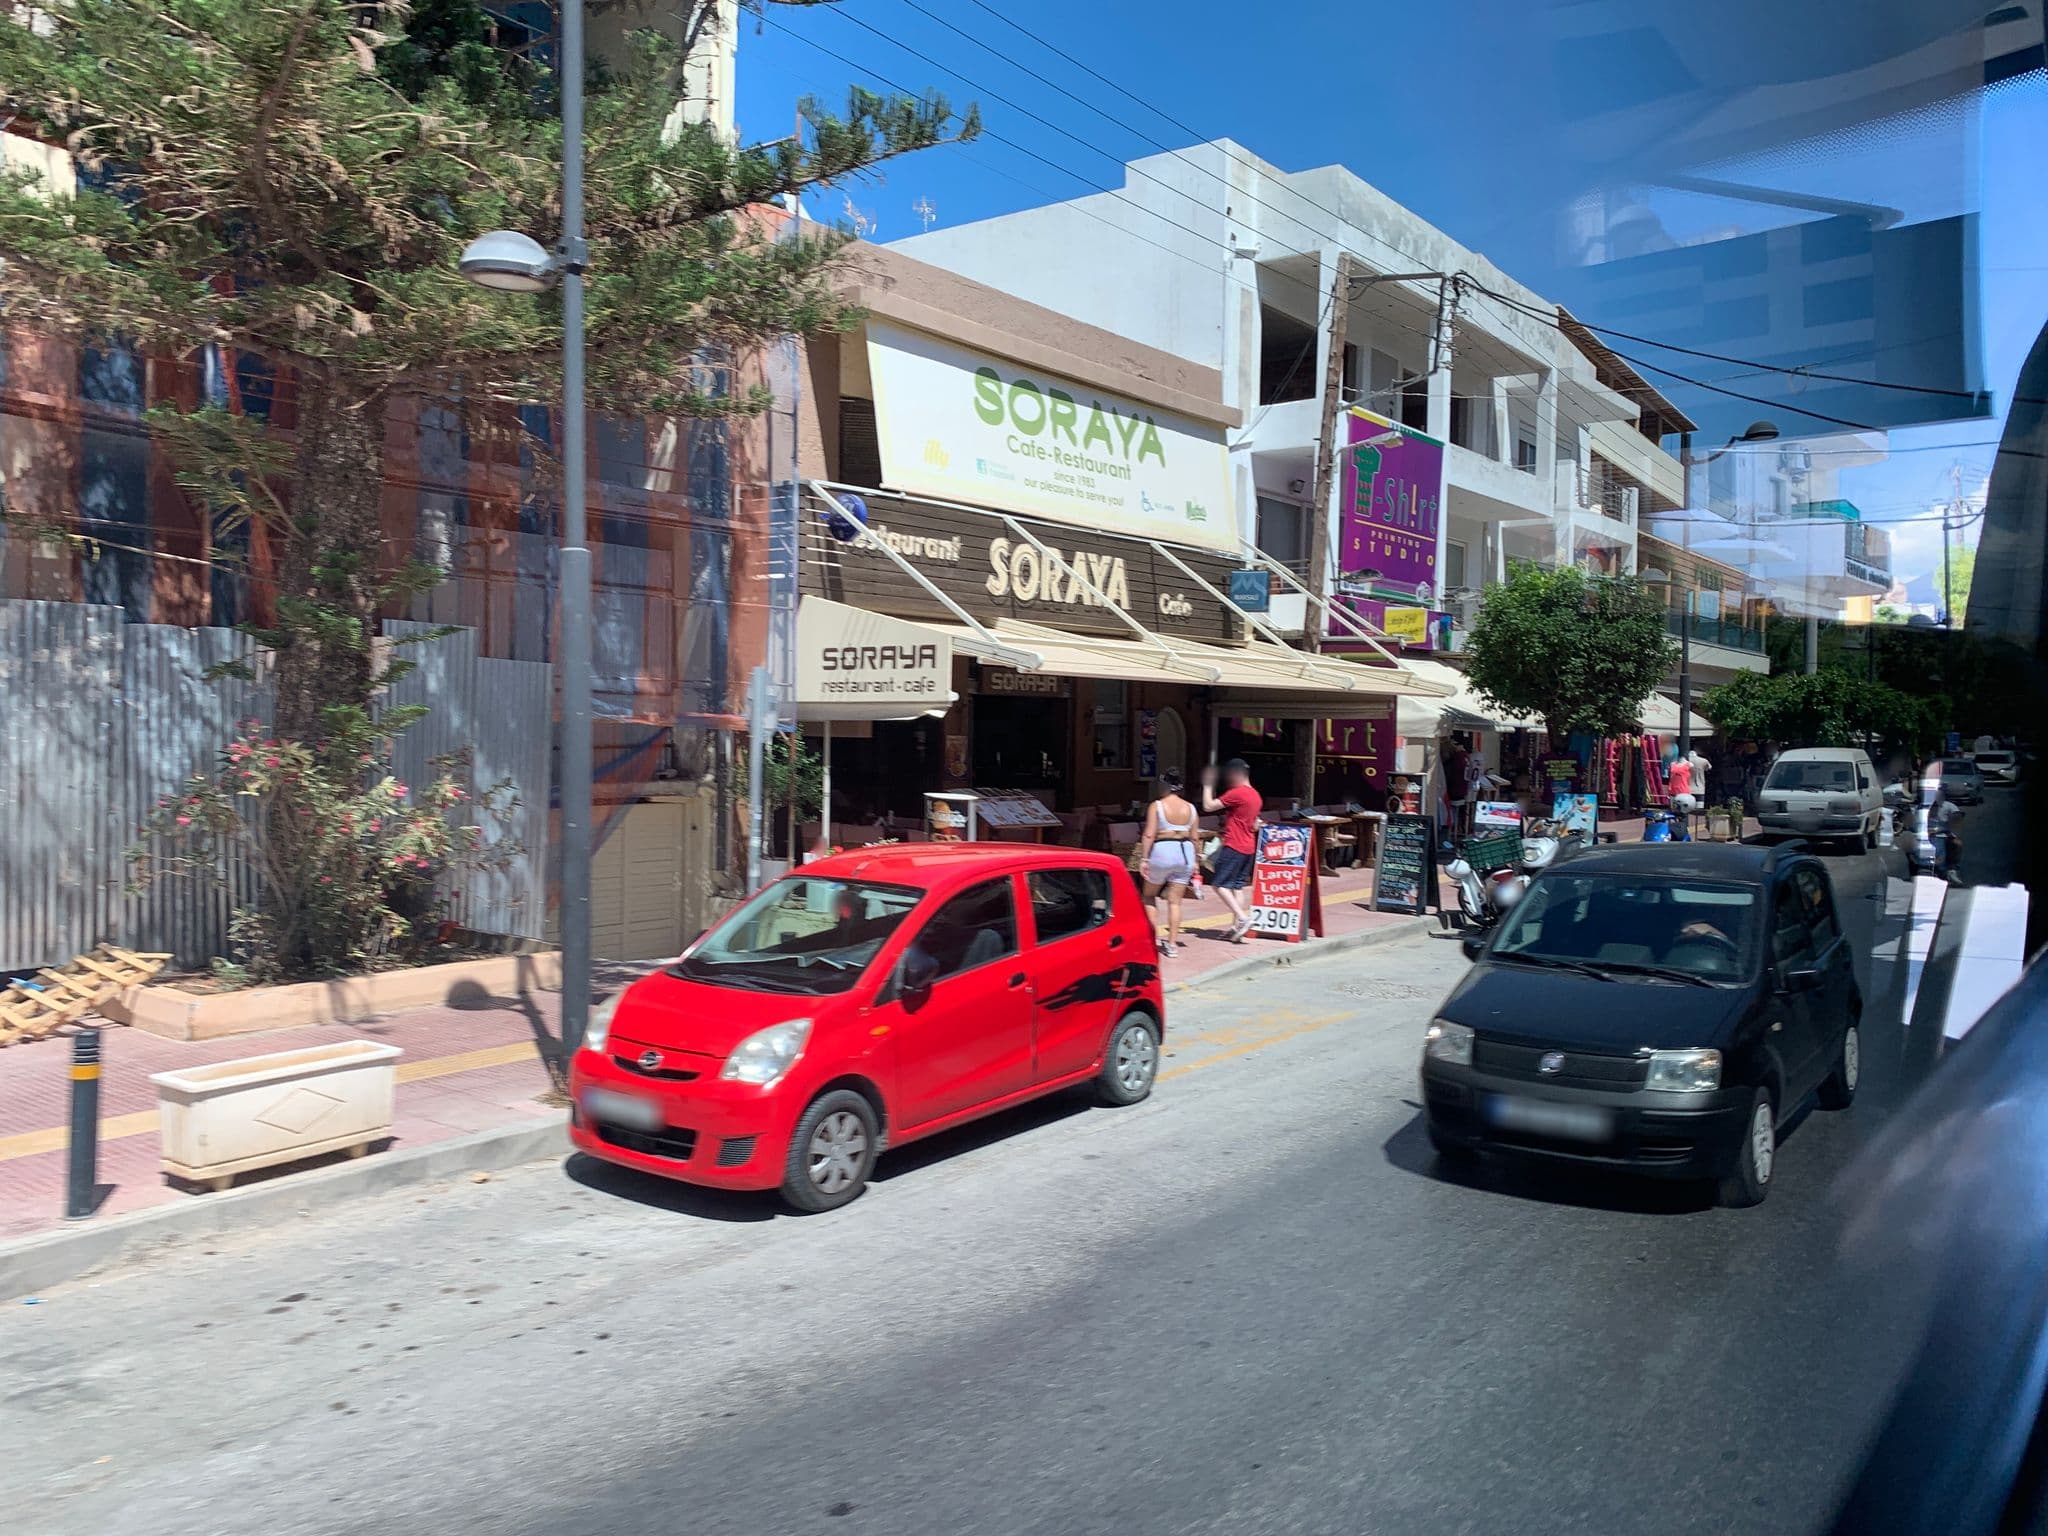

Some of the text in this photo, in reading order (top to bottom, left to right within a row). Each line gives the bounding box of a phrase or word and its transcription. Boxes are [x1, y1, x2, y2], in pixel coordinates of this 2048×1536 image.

[974, 367, 1166, 469] SORAYA
[1054, 471, 1075, 484] since
[1039, 480, 1075, 497] pleasure
[1371, 530, 1420, 548] PRINTING
[1354, 538, 1434, 566] STUDIO
[985, 537, 1131, 610] SORAYA
[822, 644, 936, 670] SORAYA
[991, 673, 1057, 692] SORAYA
[1268, 828, 1298, 840] Free
[1257, 869, 1302, 880] Large
[1260, 879, 1301, 893] Local
[1262, 894, 1300, 905] Beer
